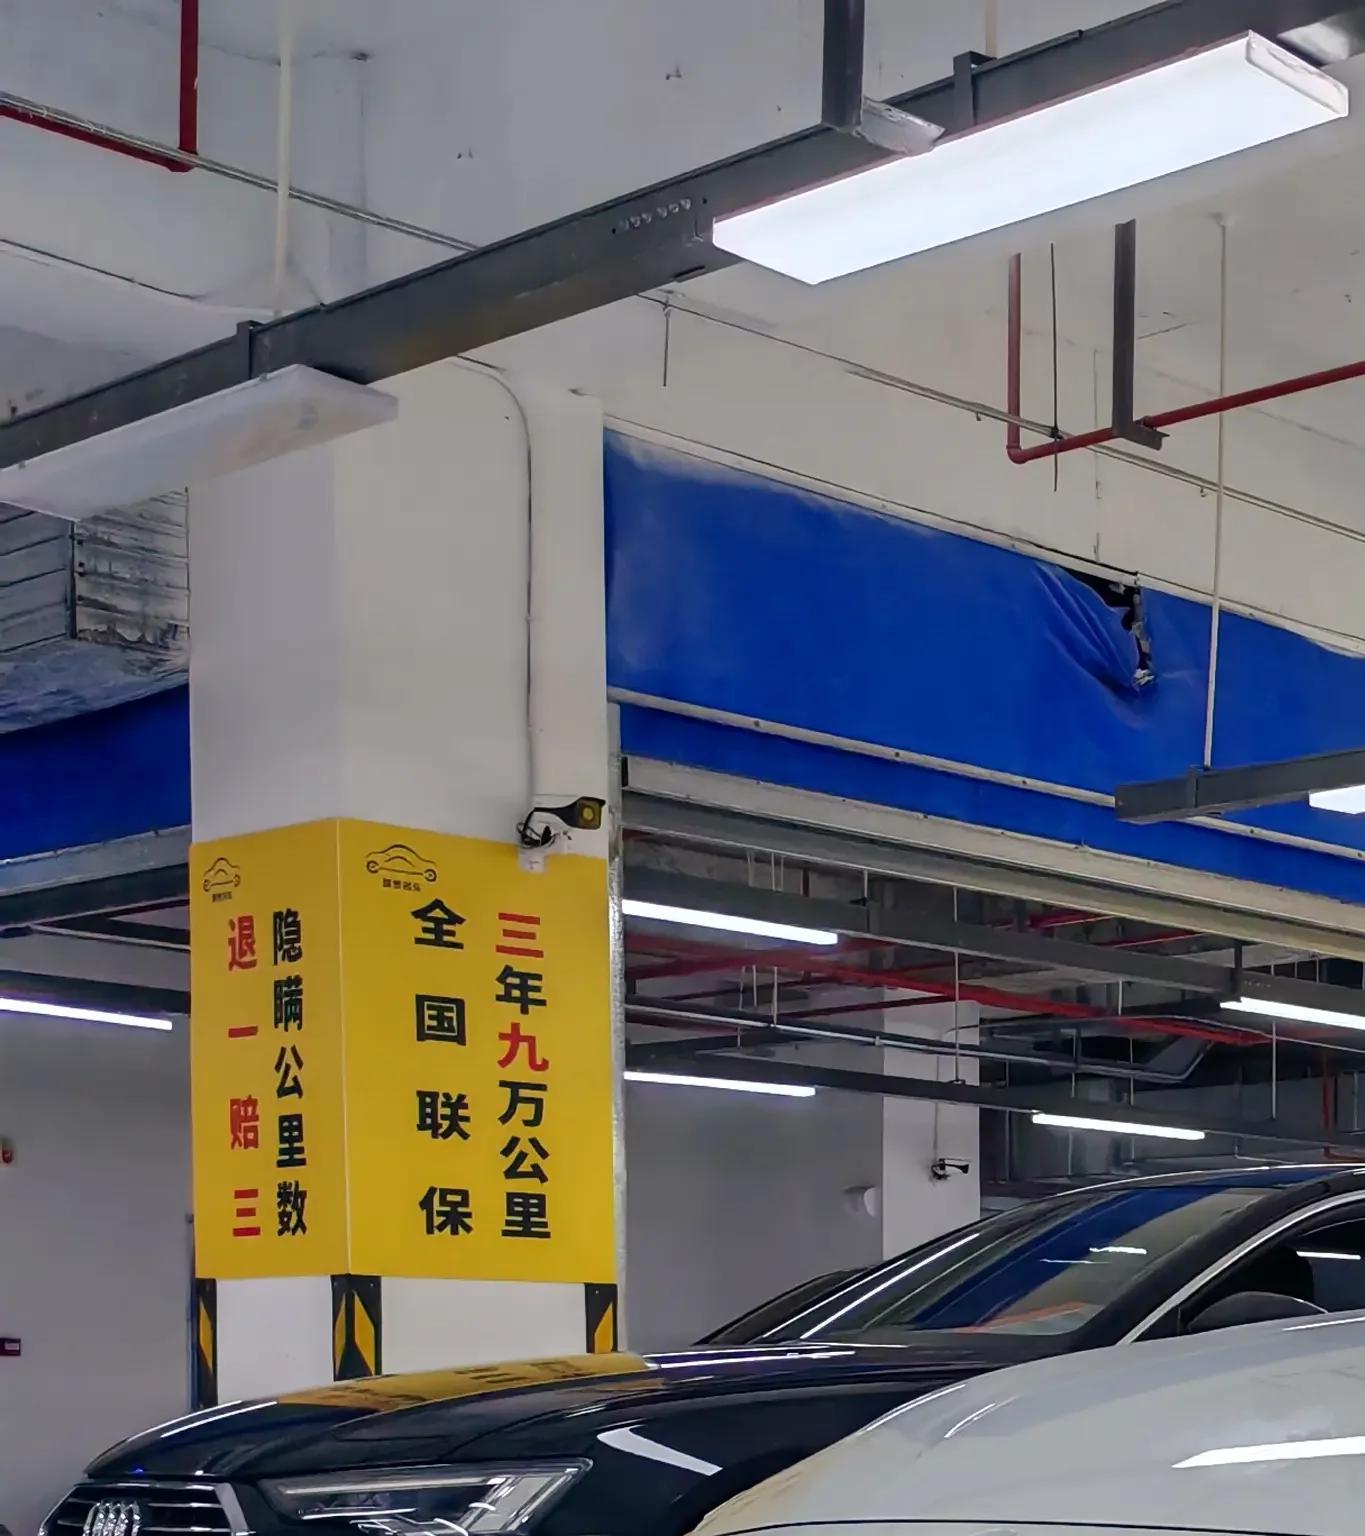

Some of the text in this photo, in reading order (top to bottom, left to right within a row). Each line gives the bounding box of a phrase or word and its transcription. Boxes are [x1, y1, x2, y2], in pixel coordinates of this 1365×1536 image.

[228, 914, 261, 1237] 退一赔三
[272, 908, 308, 1237] 隐瞒公里数
[410, 898, 474, 1236] 全国联保
[495, 911, 551, 1239] 三年九万公里
